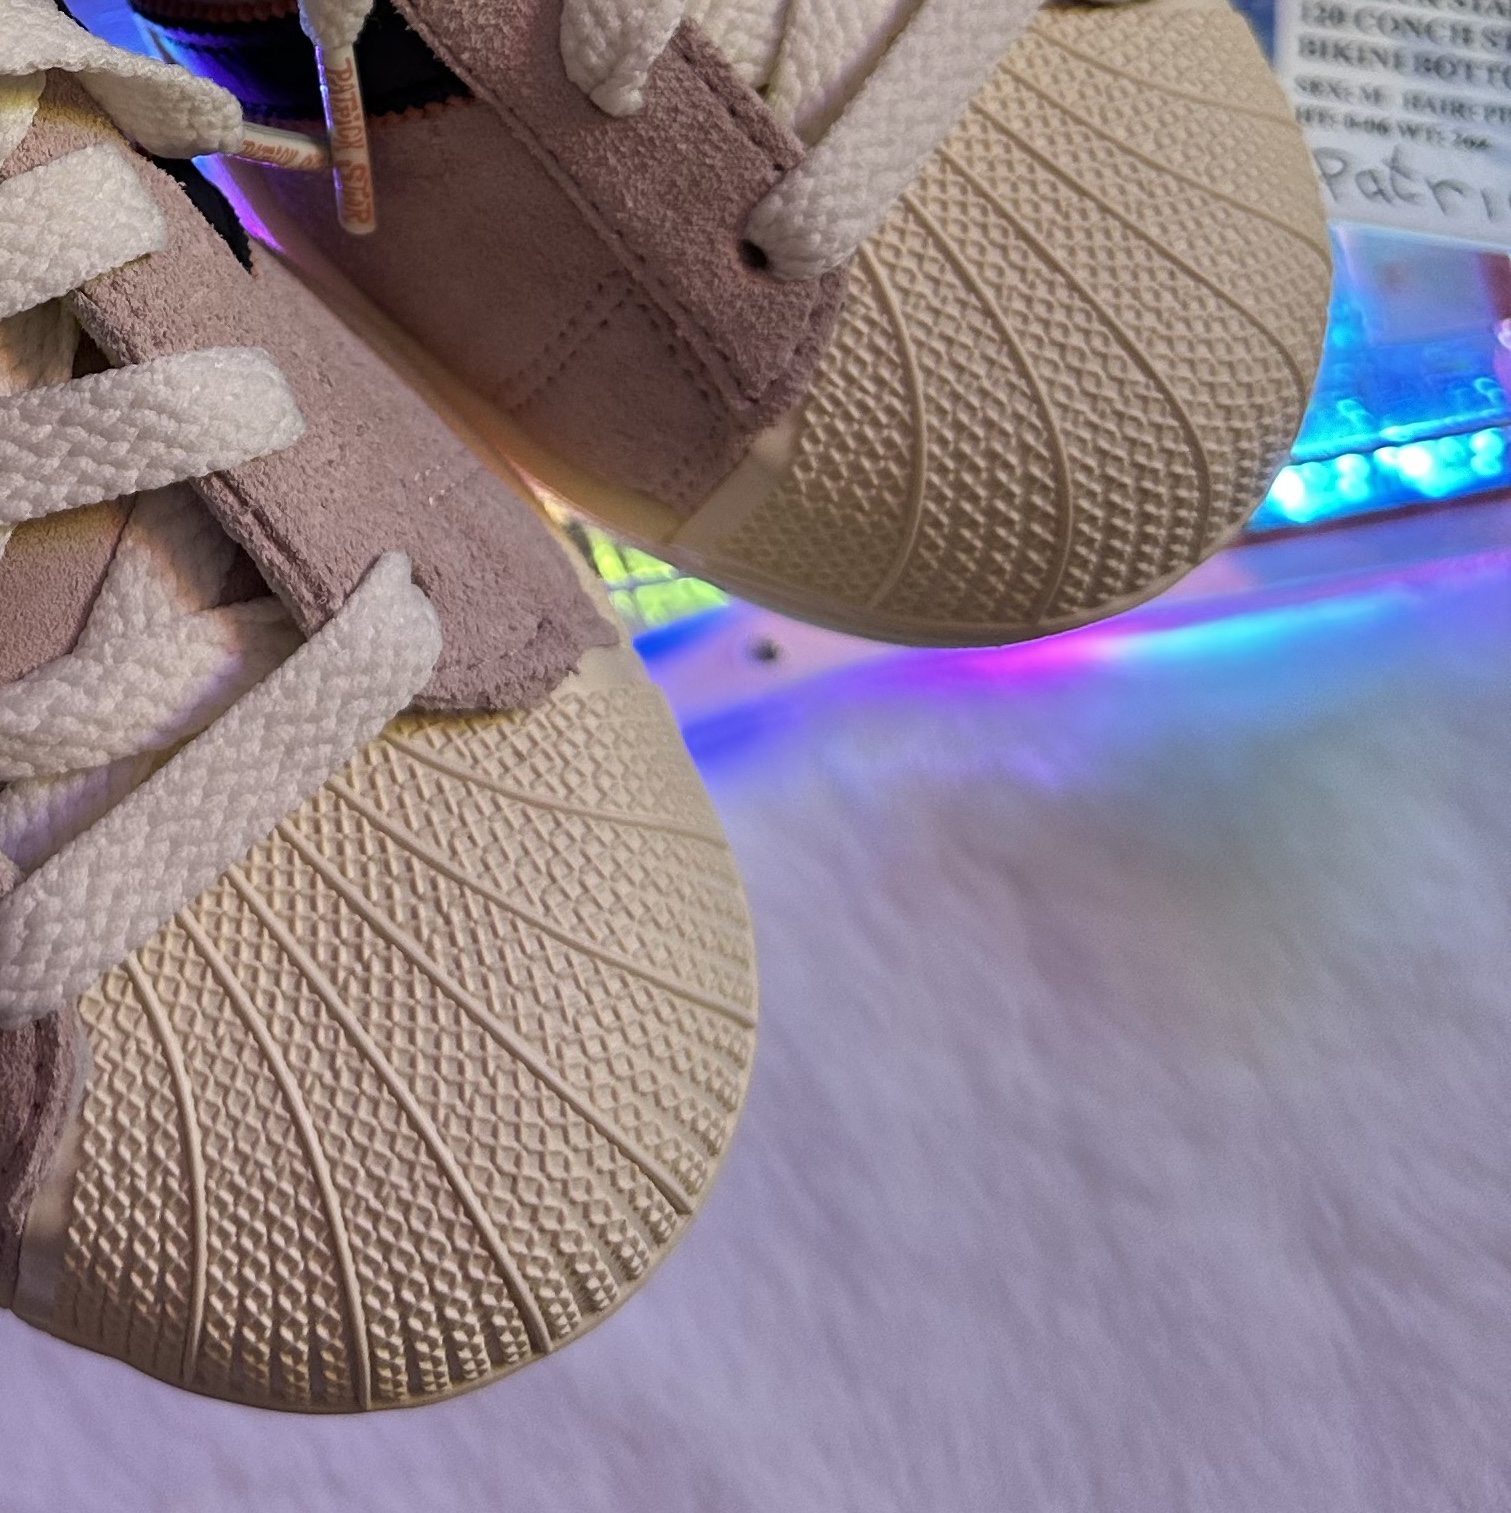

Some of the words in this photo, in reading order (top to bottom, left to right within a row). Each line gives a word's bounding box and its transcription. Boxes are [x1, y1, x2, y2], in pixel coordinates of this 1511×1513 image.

[1353, 4, 1474, 48] CONCH
[1298, 34, 1406, 72] BIKINI
[1312, 142, 1511, 222] Patri
